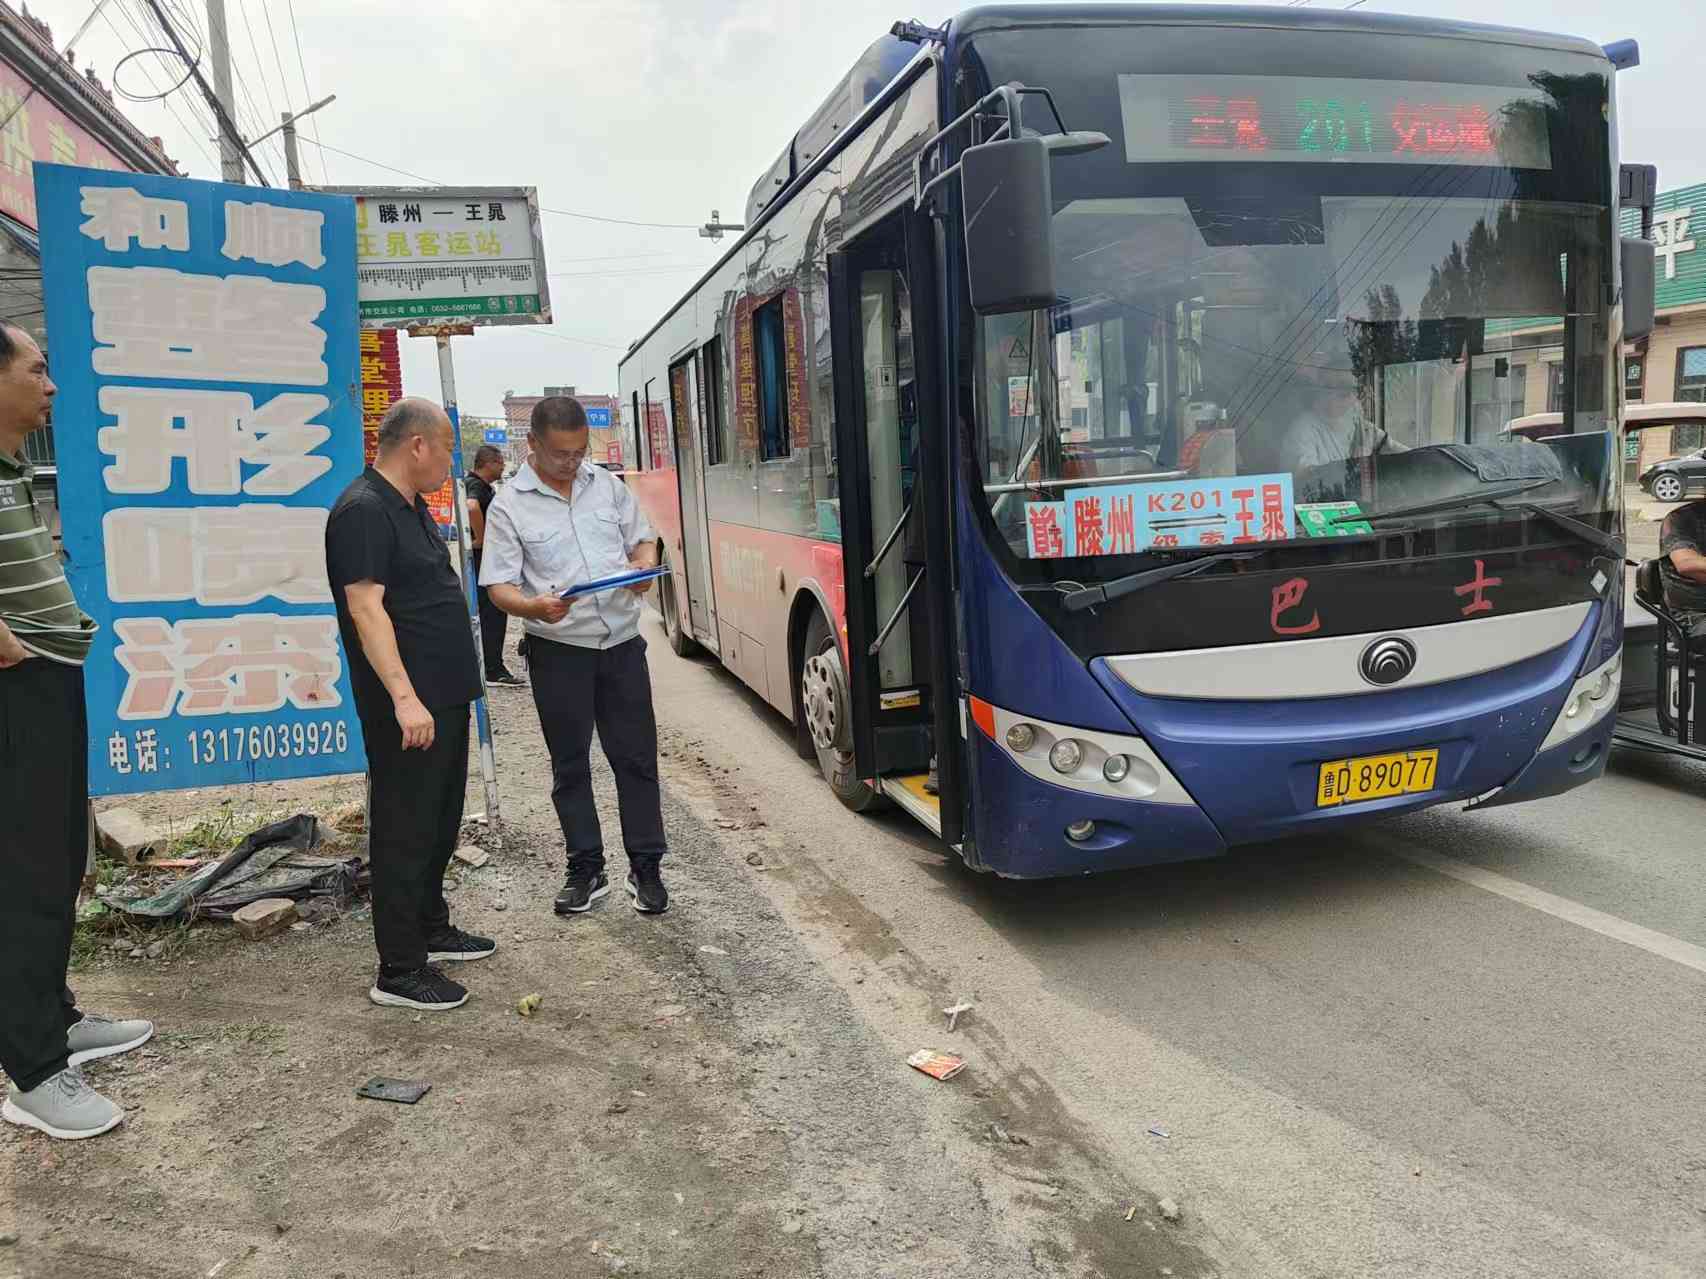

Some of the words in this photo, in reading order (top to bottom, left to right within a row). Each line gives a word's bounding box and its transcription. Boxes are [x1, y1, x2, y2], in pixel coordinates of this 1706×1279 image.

[379, 204, 422, 223] 滕州
[465, 203, 506, 221] 王晁
[358, 228, 500, 257] 王晁客运站
[1148, 490, 1222, 513] K201
[1231, 484, 1289, 544] 王晁
[1270, 577, 1321, 635] 巴
[1454, 559, 1502, 616] 士
[108, 728, 170, 774] 电话:
[187, 719, 347, 764] 13176039926
